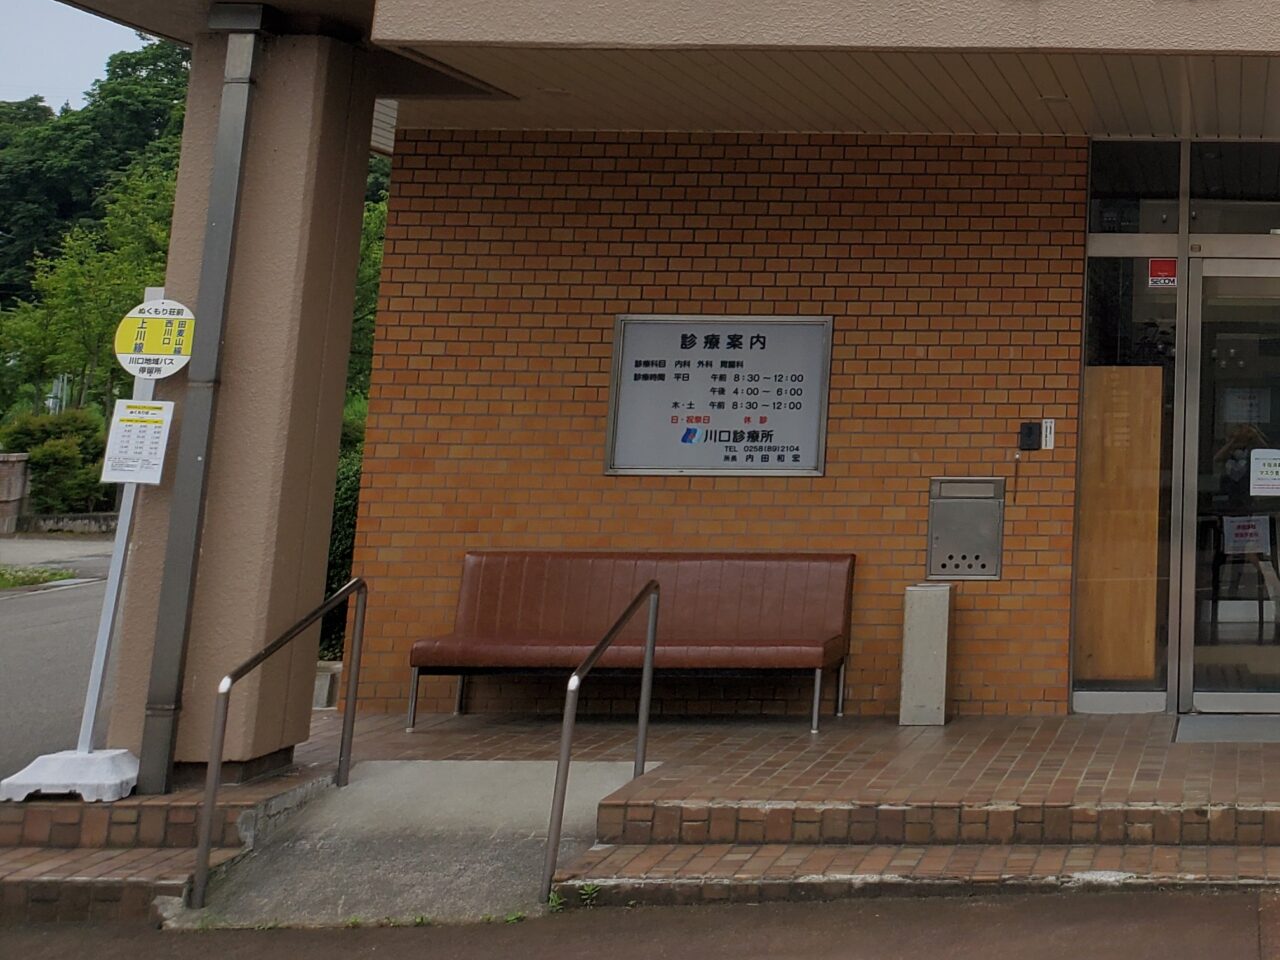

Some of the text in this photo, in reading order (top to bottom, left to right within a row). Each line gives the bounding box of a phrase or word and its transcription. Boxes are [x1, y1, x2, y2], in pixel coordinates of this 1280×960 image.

[680, 333, 767, 350] 診療案内
[674, 360, 691, 368] 内科
[697, 360, 713, 368] 外科
[673, 373, 690, 381] 平日
[703, 429, 775, 443] 川口診療所
[724, 445, 738, 453] TEL
